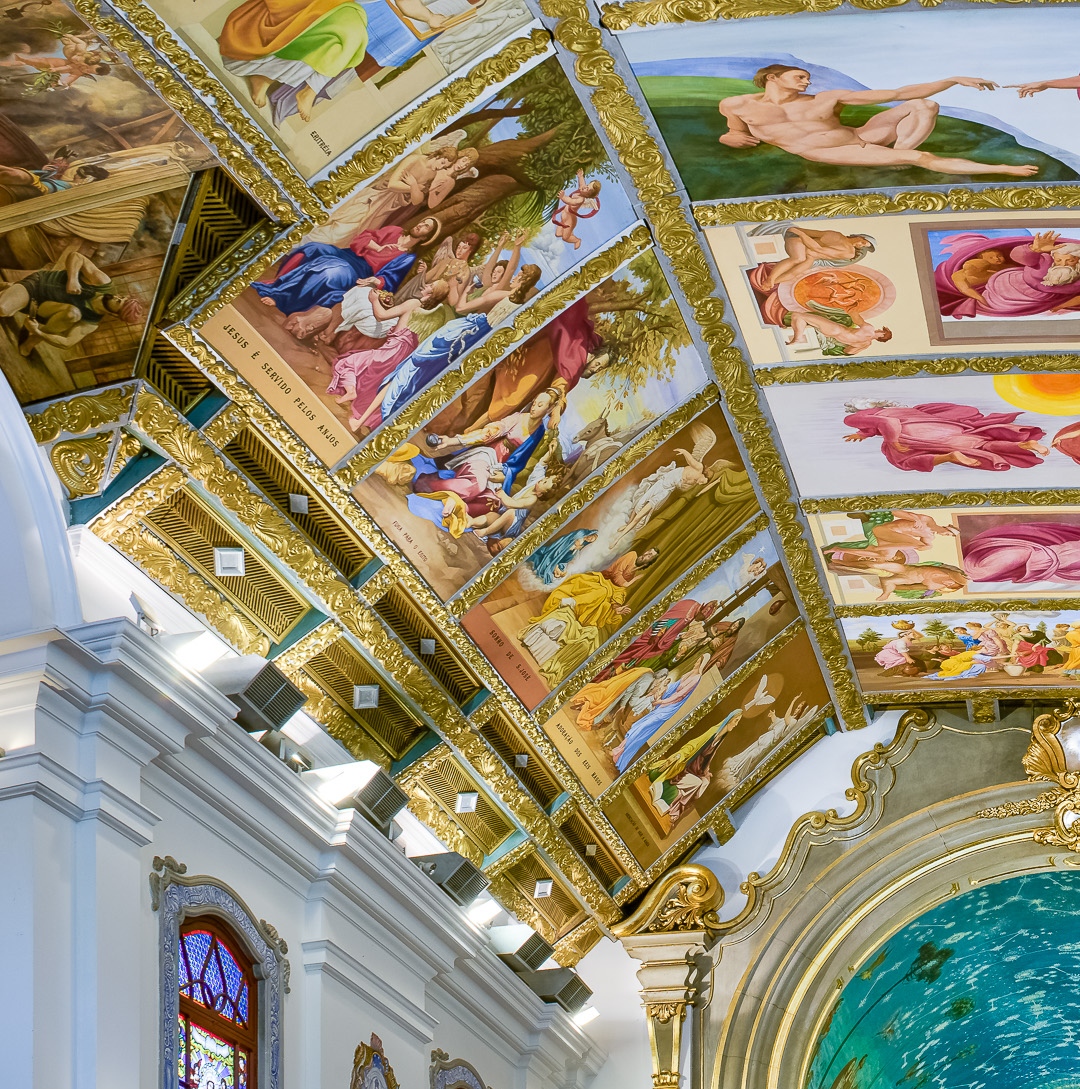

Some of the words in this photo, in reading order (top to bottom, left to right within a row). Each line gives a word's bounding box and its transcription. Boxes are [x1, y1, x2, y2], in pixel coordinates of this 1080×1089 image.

[223, 324, 249, 349] JESUS
[250, 350, 261, 360] É
[261, 362, 292, 395] SERVIDO
[293, 397, 317, 421] PELOS
[317, 424, 340, 448] ANJOS
[489, 629, 505, 648] SONHO
